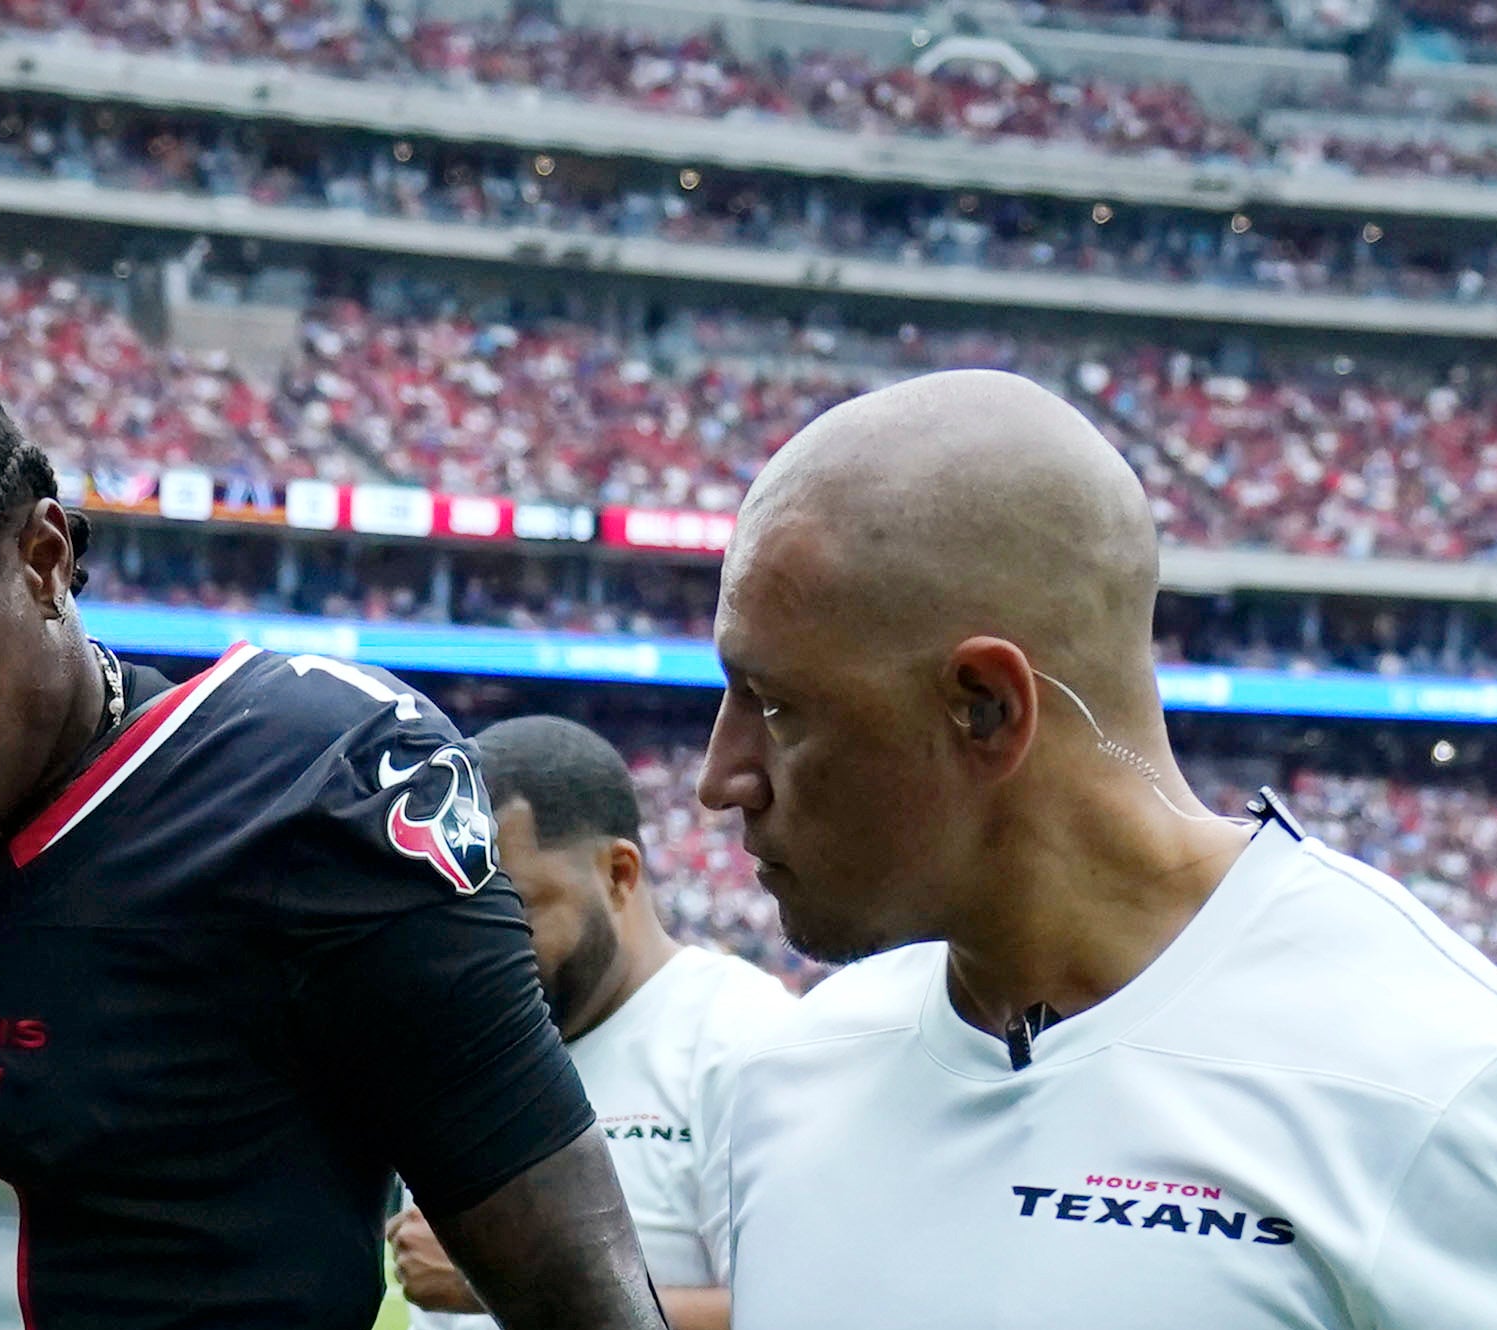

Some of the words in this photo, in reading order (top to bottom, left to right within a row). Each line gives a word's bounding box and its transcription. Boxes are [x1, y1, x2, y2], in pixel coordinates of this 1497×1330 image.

[603, 1124, 692, 1143] XANS
[1085, 1175, 1223, 1200] HOUSTON
[1012, 1186, 1296, 1246] TEXANS
